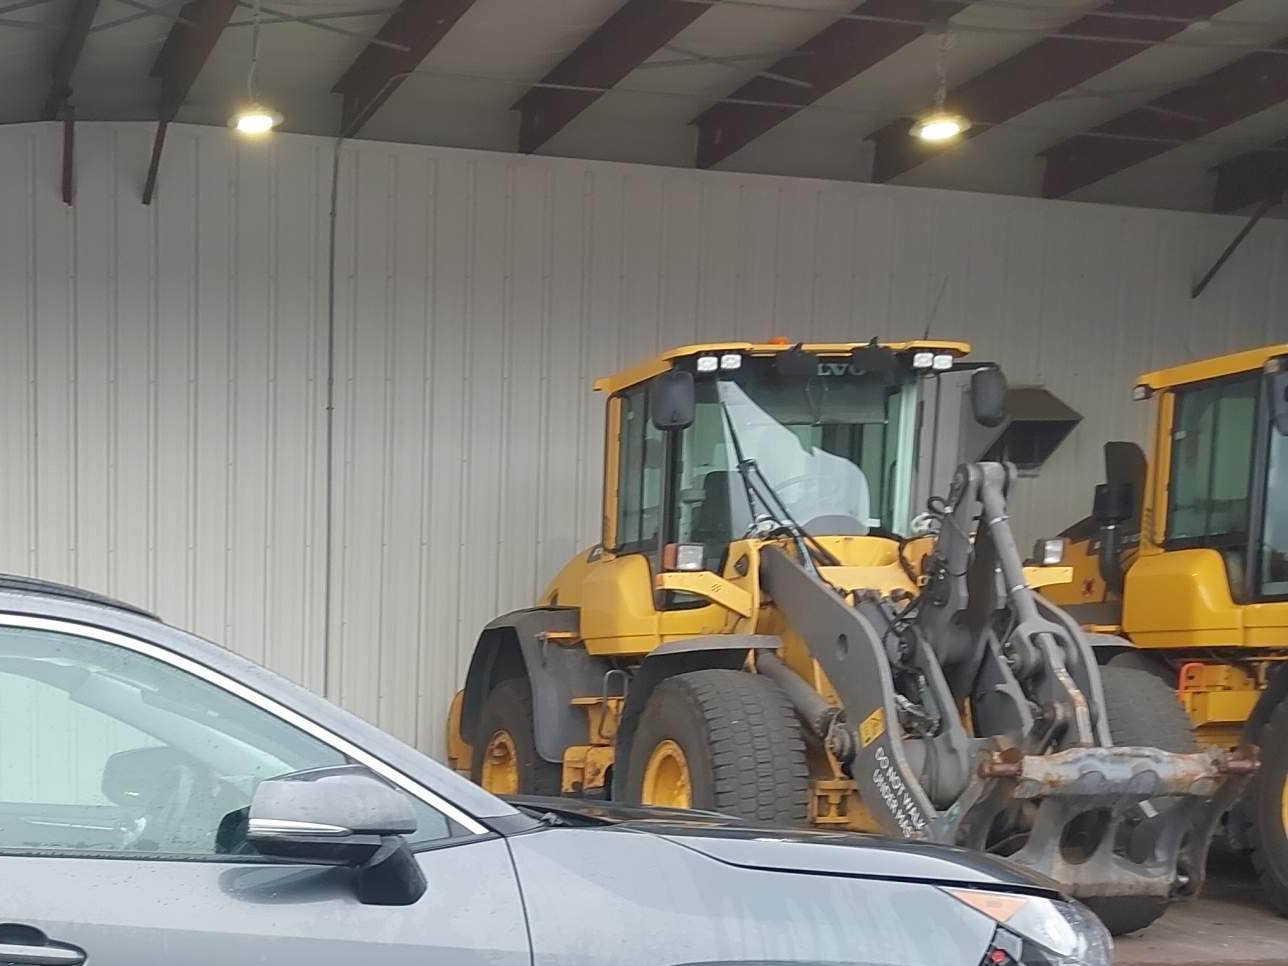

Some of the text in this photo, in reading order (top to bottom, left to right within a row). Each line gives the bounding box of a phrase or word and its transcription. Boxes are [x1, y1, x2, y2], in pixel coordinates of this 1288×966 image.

[874, 746, 927, 830] DO NOT WALK
